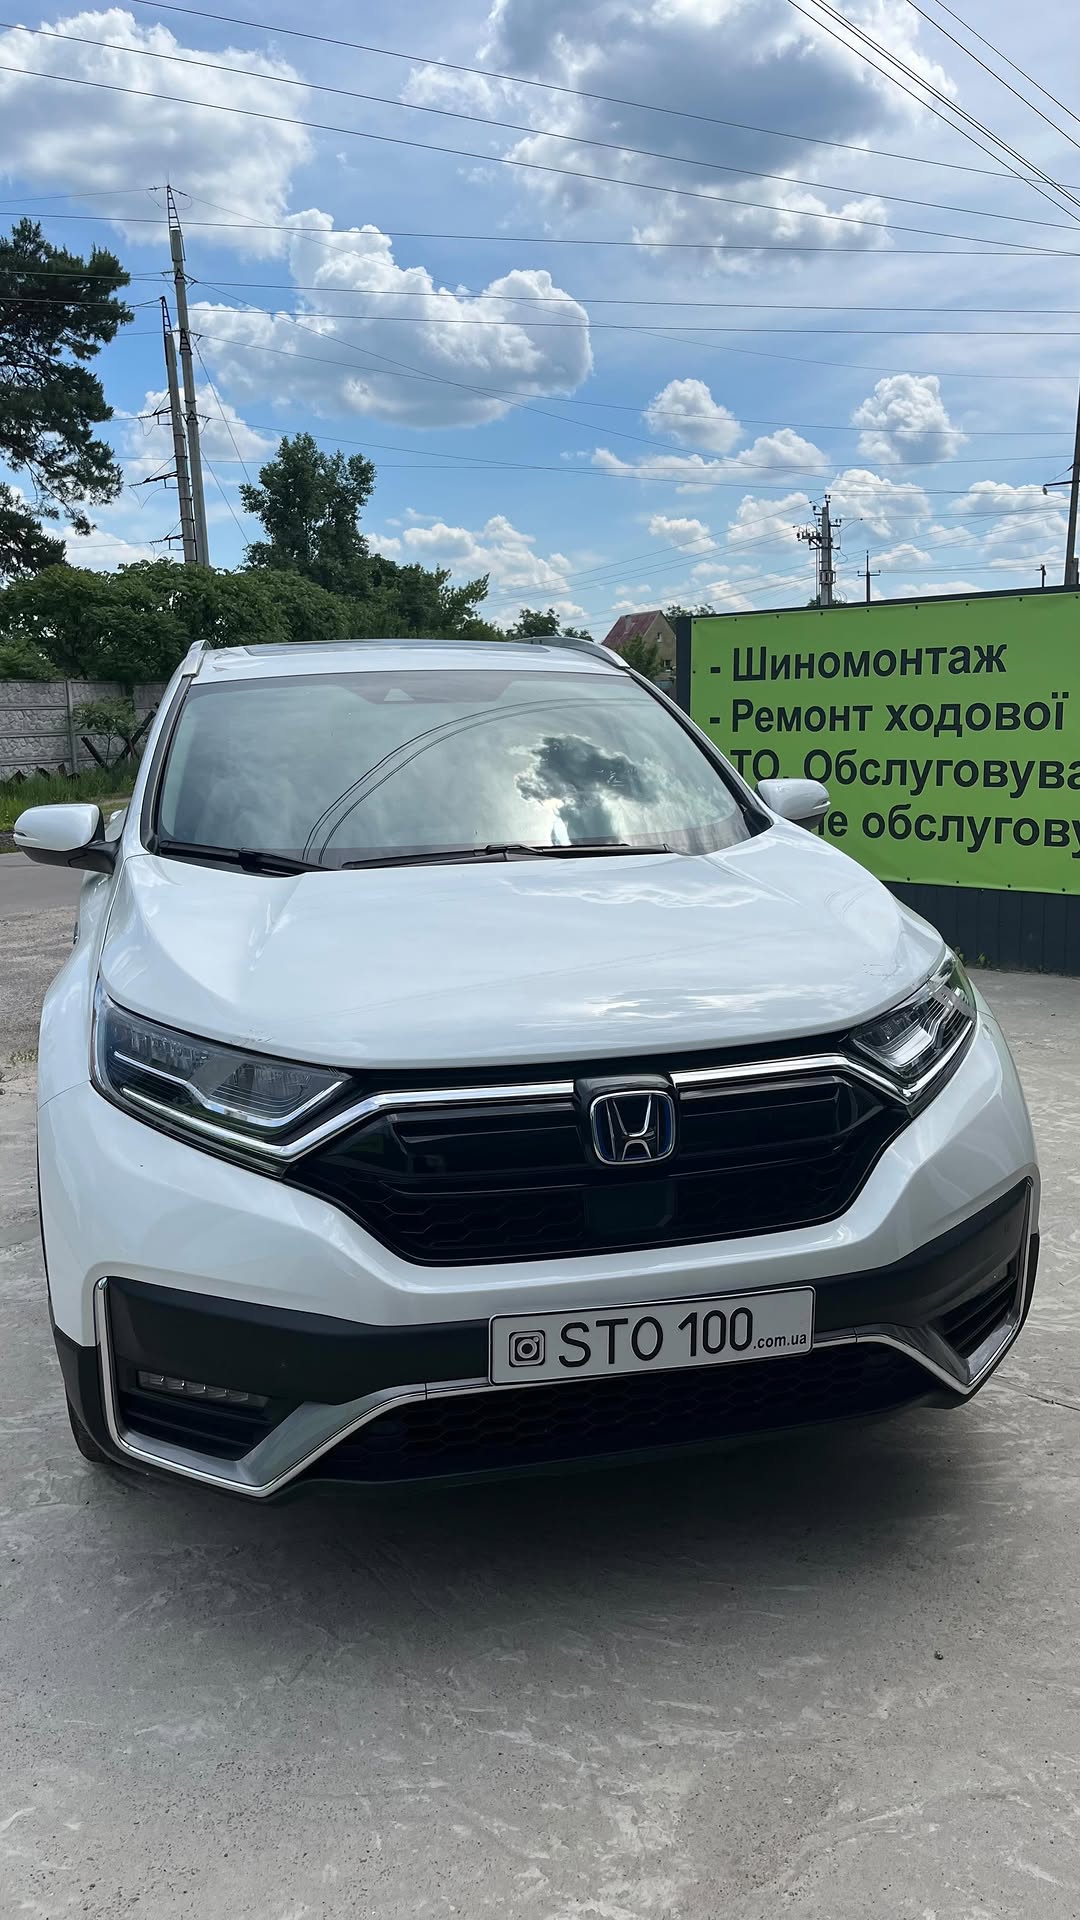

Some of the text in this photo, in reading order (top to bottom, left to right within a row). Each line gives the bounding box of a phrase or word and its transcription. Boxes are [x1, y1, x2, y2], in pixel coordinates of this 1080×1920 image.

[732, 644, 1008, 682] Шиномонтаж
[731, 699, 873, 732] Ремонт
[885, 691, 1069, 738] ходової
[558, 1316, 664, 1368] STO
